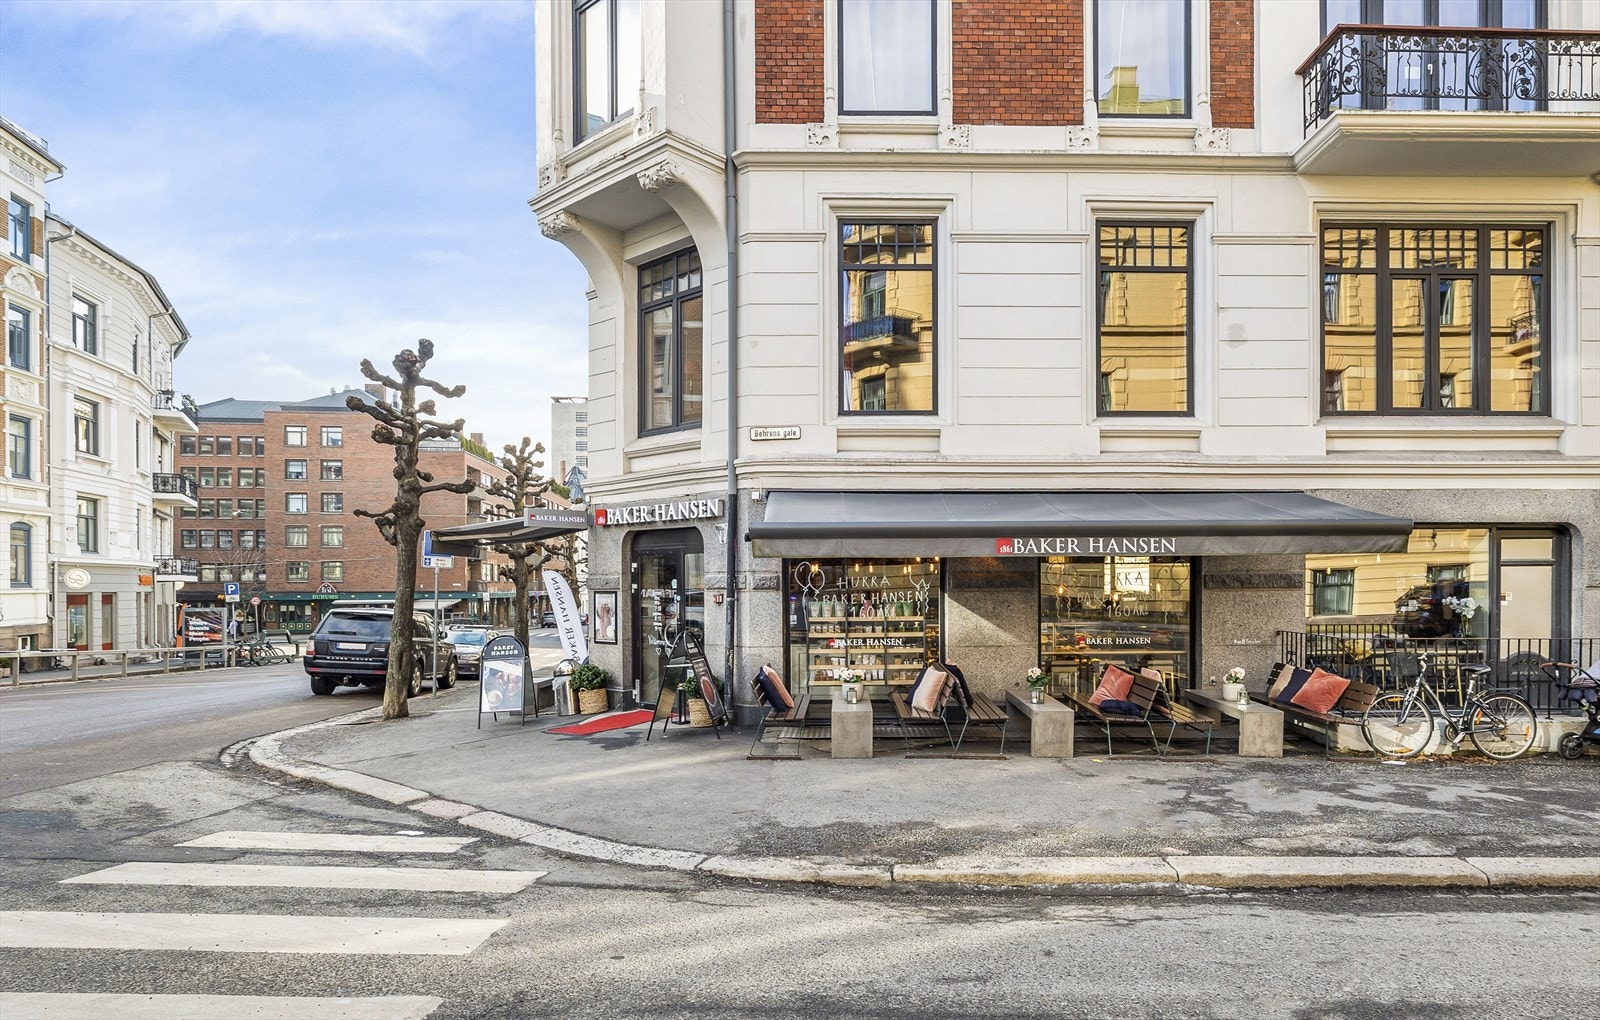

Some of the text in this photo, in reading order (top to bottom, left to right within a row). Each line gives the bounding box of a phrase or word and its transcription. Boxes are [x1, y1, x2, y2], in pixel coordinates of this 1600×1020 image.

[754, 429, 781, 438] Behrens
[606, 505, 648, 525] BAKER
[650, 498, 720, 521] HANSEN
[559, 515, 585, 523] HANSEN
[1000, 537, 1177, 554] 1861 BAKER HANSEN
[228, 584, 236, 594] P
[837, 575, 891, 590] HURRA
[822, 590, 924, 606] BAKER HANSEN
[850, 605, 875, 619] 160
[1106, 604, 1131, 618] 160
[1086, 637, 1113, 645] BAKER
[1116, 637, 1151, 645] HANSEN
